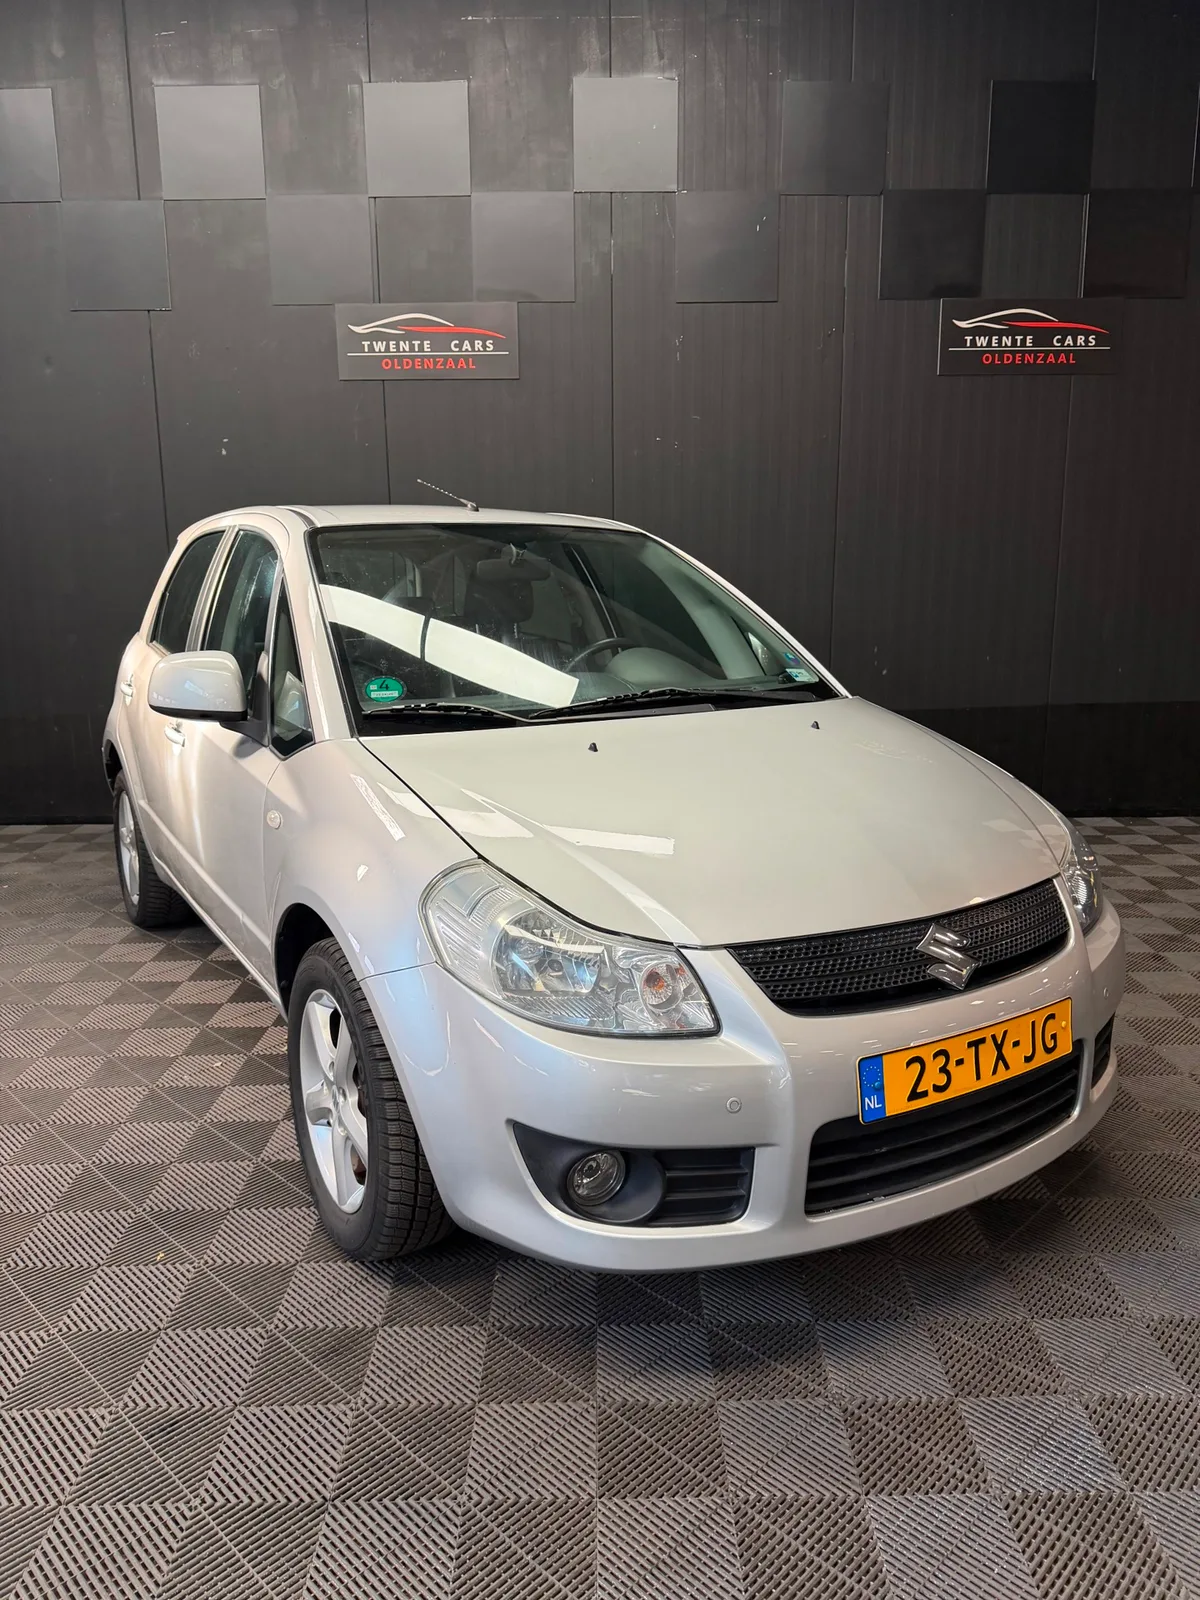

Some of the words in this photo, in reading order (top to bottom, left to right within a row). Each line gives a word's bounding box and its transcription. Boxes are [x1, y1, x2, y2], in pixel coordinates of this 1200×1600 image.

[361, 340, 431, 352] TWENTE
[450, 339, 494, 351] CARS
[964, 335, 1034, 347] TWENTE
[1052, 335, 1097, 346] CARS
[381, 357, 476, 370] OLDENZAAL
[981, 352, 1077, 364] OLDENZAAL
[379, 679, 390, 690] 4
[905, 1012, 1058, 1103] 23-TX-JG
[864, 1094, 883, 1111] NL
